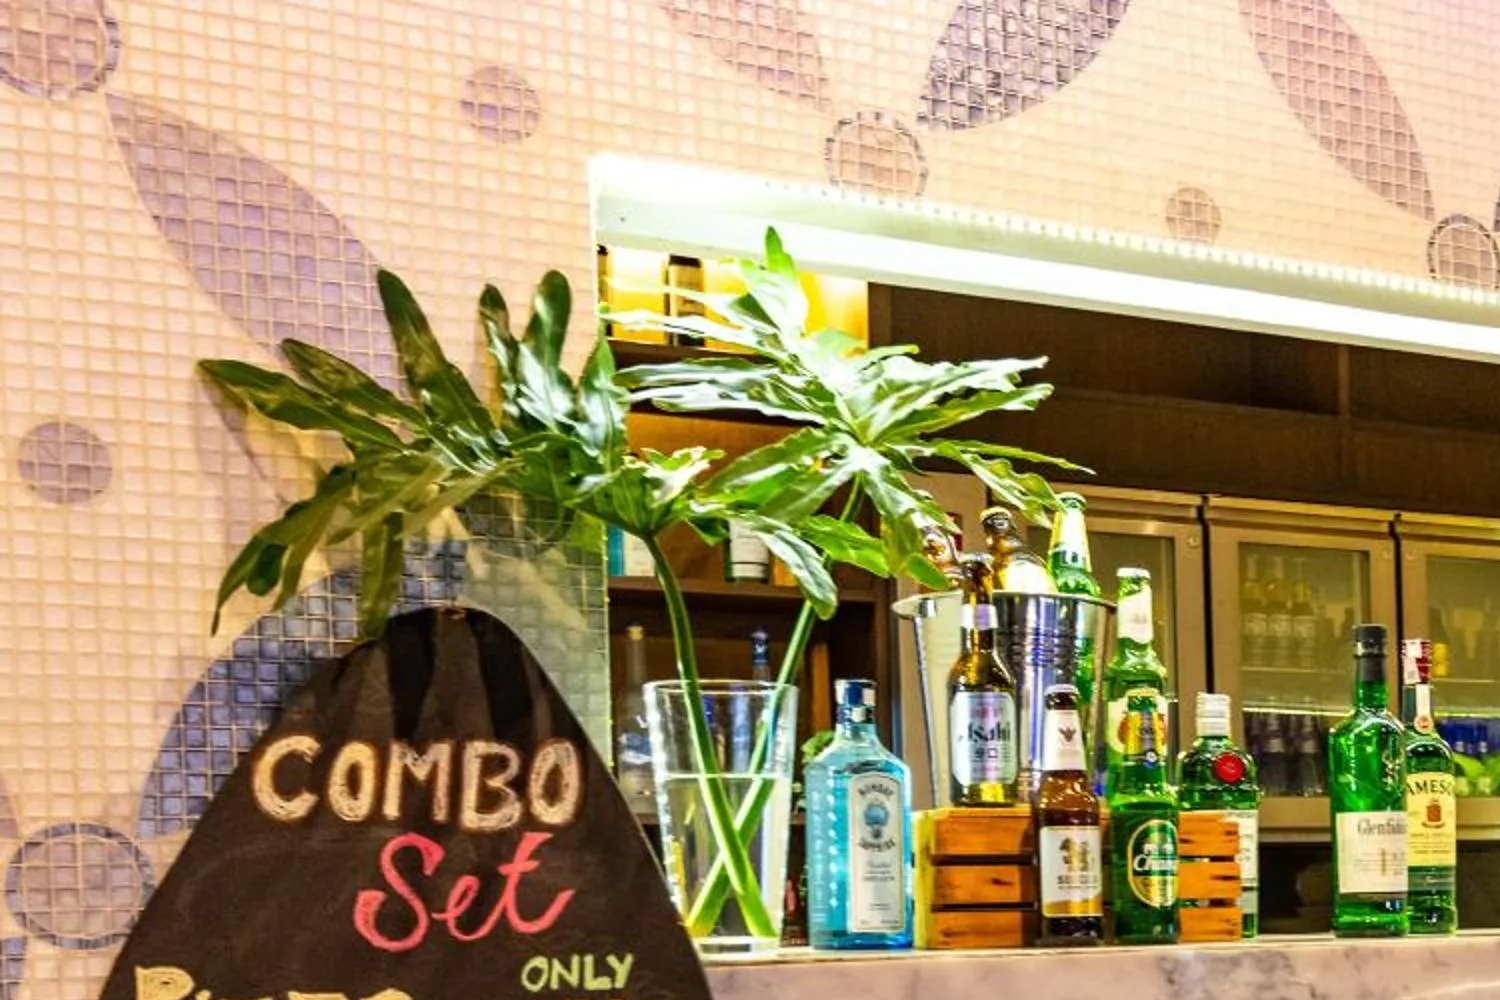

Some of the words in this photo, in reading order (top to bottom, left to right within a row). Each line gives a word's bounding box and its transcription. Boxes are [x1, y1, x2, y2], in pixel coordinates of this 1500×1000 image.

[252, 736, 584, 831] COMBO
[354, 832, 575, 951] Set
[521, 953, 635, 993] ONLY
